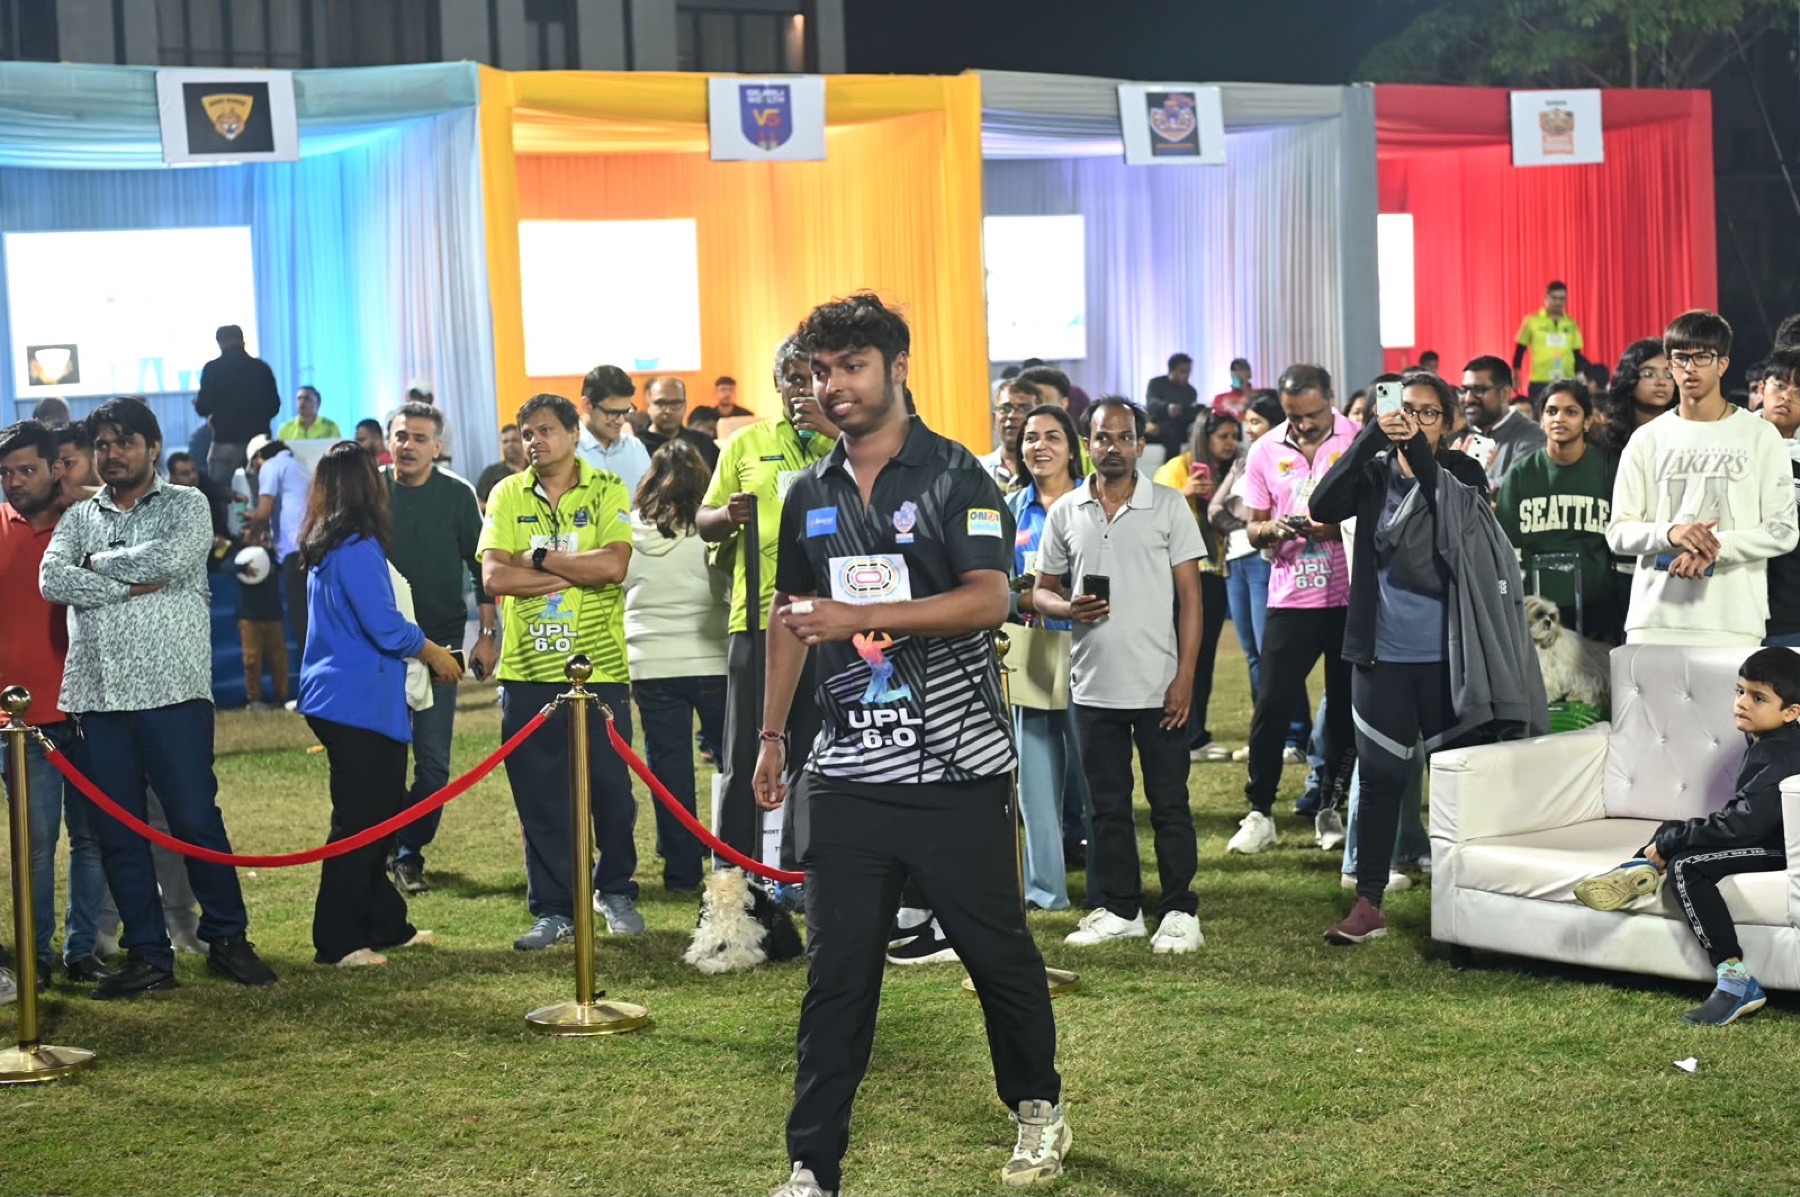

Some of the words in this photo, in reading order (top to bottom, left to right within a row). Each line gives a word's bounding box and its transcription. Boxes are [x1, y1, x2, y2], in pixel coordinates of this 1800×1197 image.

[1520, 494, 1610, 534] SEATTLE
[1296, 576, 1327, 589] 6.0
[529, 623, 578, 637] UPL
[534, 638, 571, 652] 6.0
[848, 708, 923, 728] UPL
[862, 727, 916, 748] 6.0
